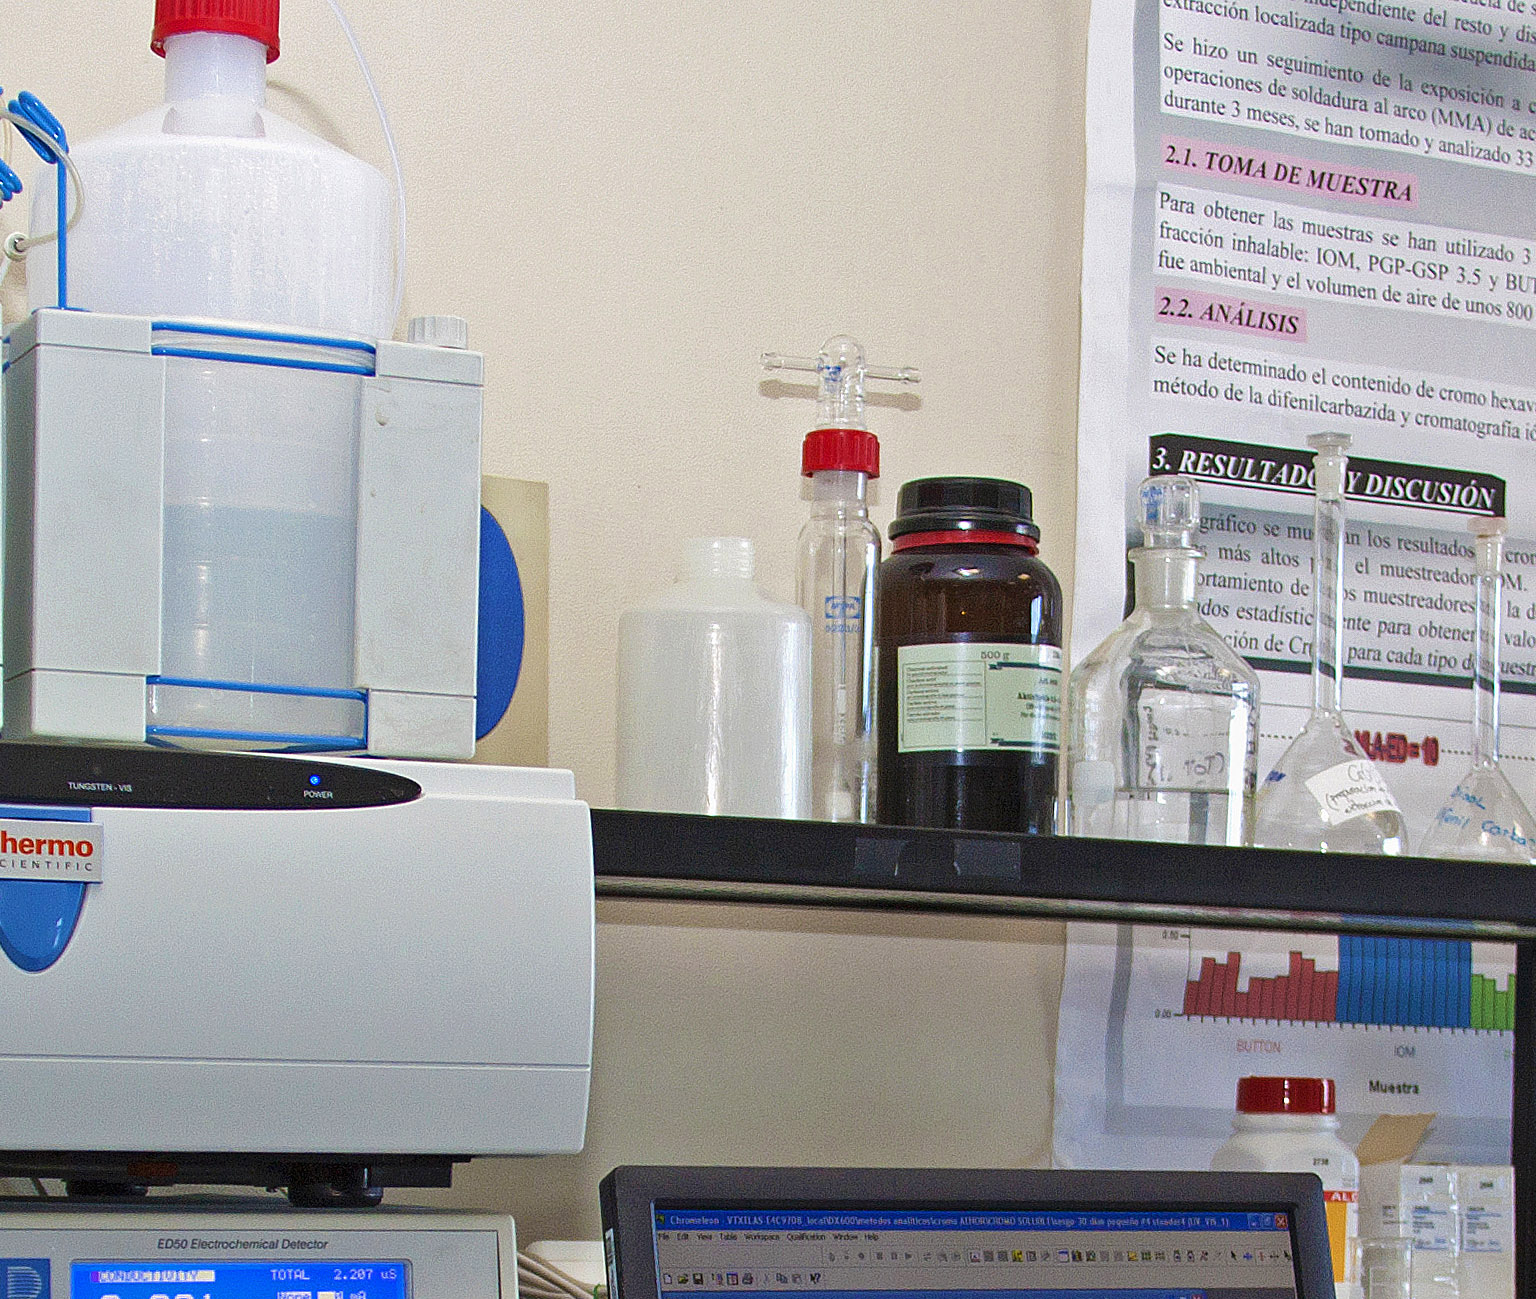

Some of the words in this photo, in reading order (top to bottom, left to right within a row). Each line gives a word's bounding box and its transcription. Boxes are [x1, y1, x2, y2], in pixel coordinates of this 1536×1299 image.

[1164, 32, 1183, 51] Se
[1193, 37, 1228, 59] hizo
[1237, 48, 1257, 64] un
[1267, 54, 1363, 83] seguimiento
[1373, 69, 1391, 87] de
[1400, 73, 1412, 91] la
[1421, 81, 1504, 107] exposición
[1165, 145, 1196, 167] 2.1.
[1206, 151, 1266, 179] TOMA
[1274, 162, 1302, 183] DE
[1306, 170, 1412, 201] MUESTRA
[1159, 191, 1194, 214] Para
[1204, 202, 1264, 225] obtener
[1273, 211, 1293, 231] las
[1302, 220, 1373, 243] muestras
[1382, 232, 1399, 247] se
[1408, 231, 1436, 251] han
[1446, 239, 1513, 262] utilizado
[1523, 248, 1530, 264] 3
[1158, 296, 1192, 319] 2.2.
[1200, 302, 1299, 334] ANÁLISIS
[1155, 346, 1176, 364] Se
[1183, 348, 1202, 367] ha
[1208, 352, 1307, 382] determinado
[1312, 368, 1325, 385] el
[1332, 373, 1411, 395] contenido
[1416, 380, 1434, 398] de
[1439, 389, 1486, 408] cromo
[1152, 447, 1171, 471] 3.
[1179, 450, 1316, 487] RESULTAD
[1346, 471, 1361, 493] Y
[1366, 474, 1495, 509] DISCUSIÓN
[981, 651, 1001, 659] 500
[68, 782, 113, 791] TUNGSTEN
[303, 790, 333, 799] POWER
[1237, 1040, 1280, 1053] BUTTON
[1395, 1046, 1415, 1056] IOM
[1369, 1080, 1419, 1094] Muestra
[157, 1238, 188, 1250] ED50
[191, 1238, 278, 1250] Electrochemical
[281, 1238, 328, 1251] Detector
[271, 1269, 310, 1280] TOTAL
